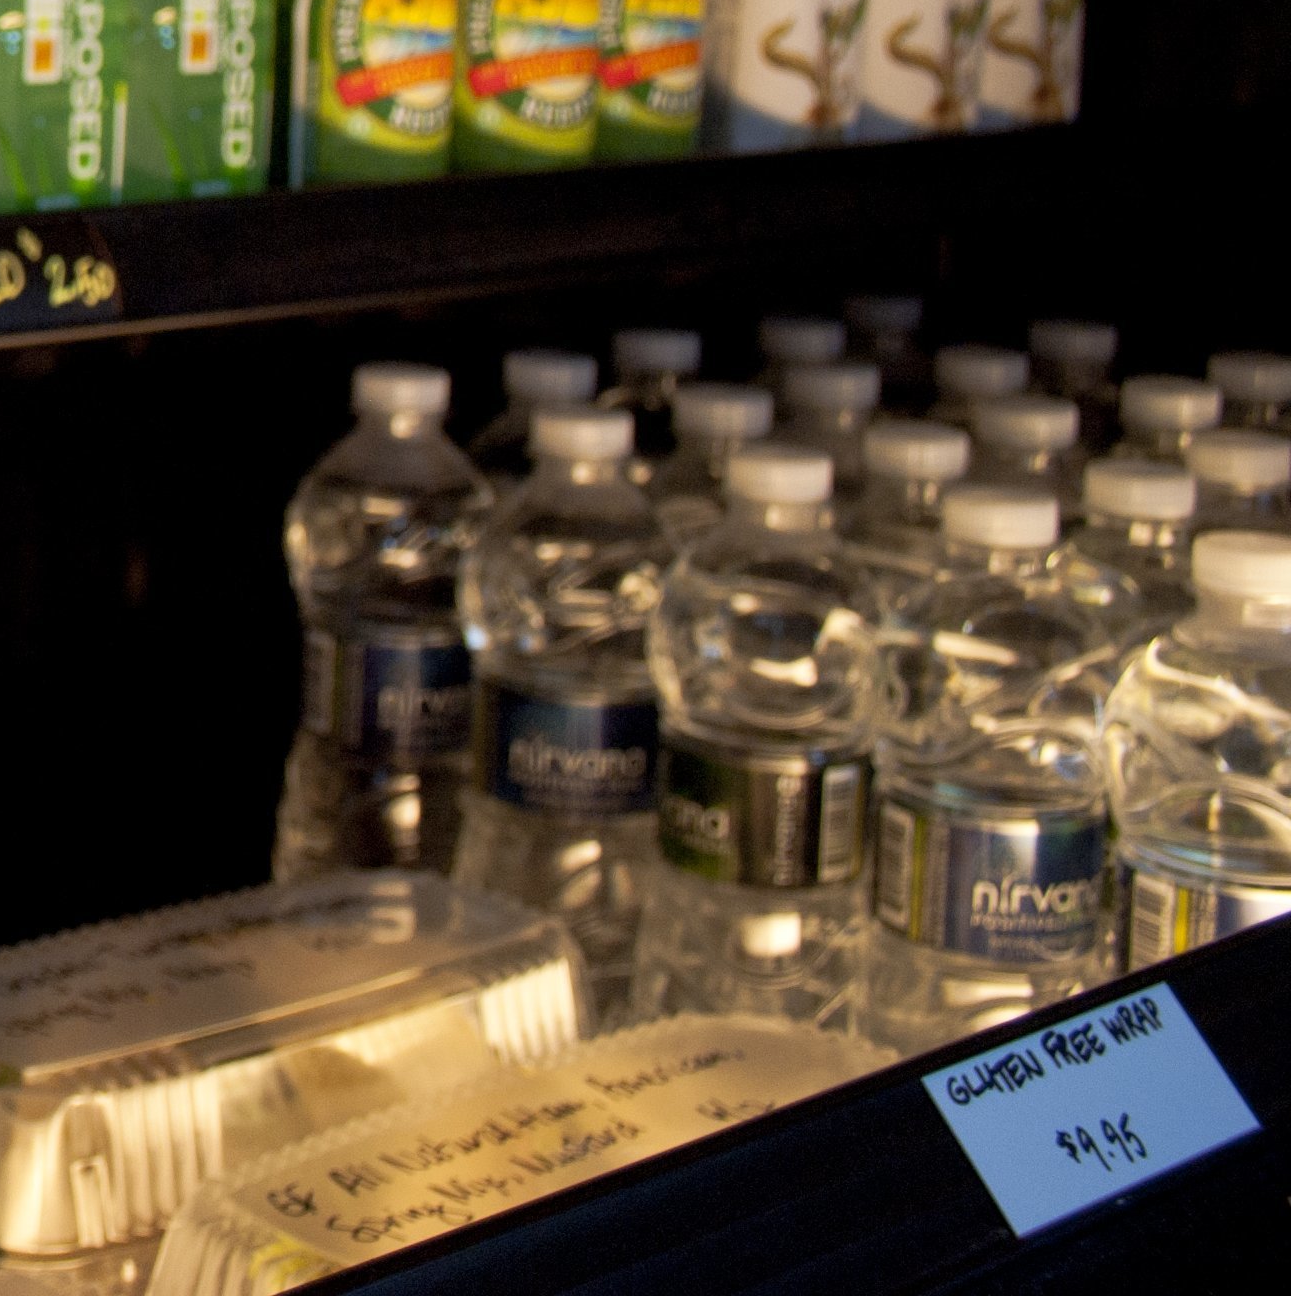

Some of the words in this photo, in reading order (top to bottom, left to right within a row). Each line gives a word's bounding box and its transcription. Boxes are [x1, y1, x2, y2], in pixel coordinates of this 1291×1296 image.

[945, 1048, 1046, 1106] GLUTEN
[1040, 1022, 1107, 1070] FREE
[1104, 996, 1164, 1045] WRAP
[1055, 1112, 1148, 1173] $9.95
